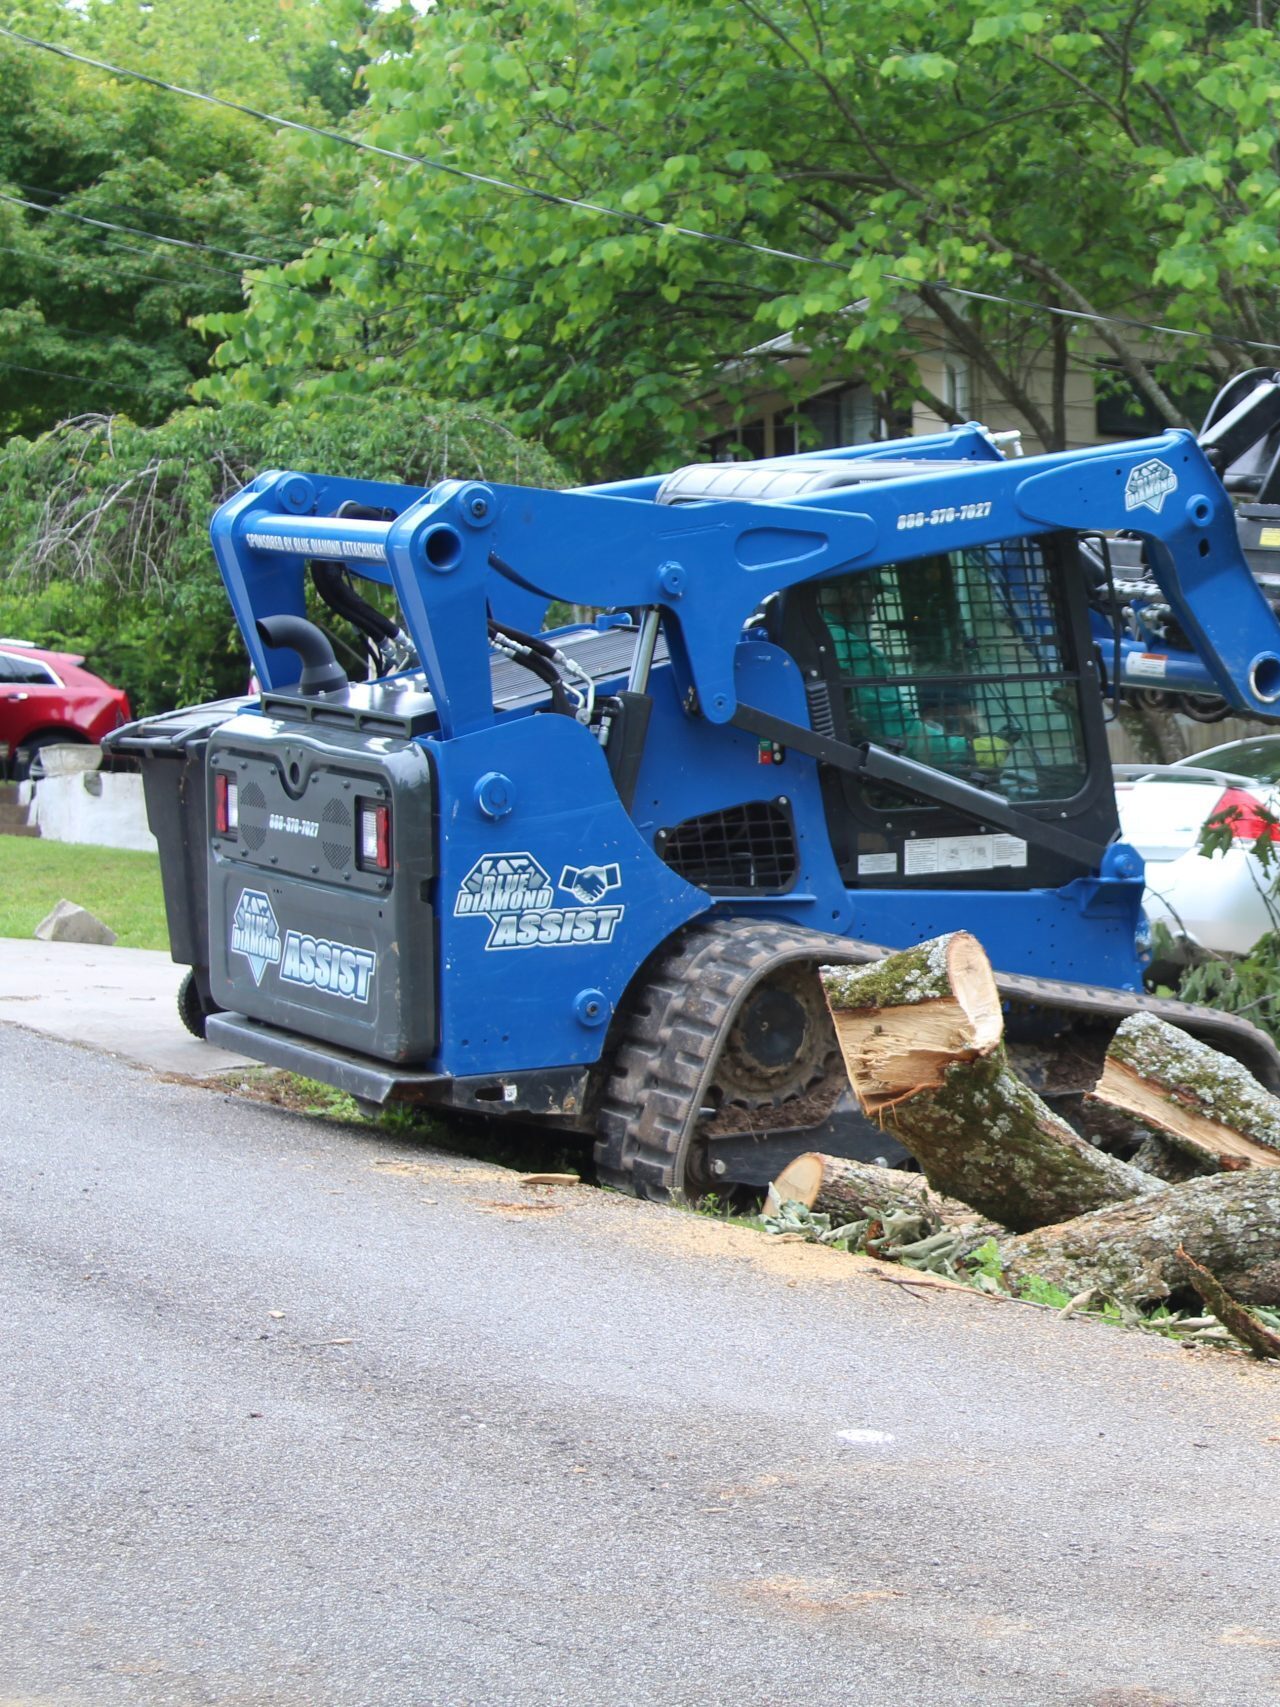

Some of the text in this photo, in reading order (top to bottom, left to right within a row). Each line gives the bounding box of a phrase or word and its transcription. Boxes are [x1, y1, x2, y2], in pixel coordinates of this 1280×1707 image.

[480, 873, 531, 893] BLUE
[457, 889, 552, 912] DIAMOND
[244, 912, 269, 937] BLUE
[491, 909, 620, 946] ASSIST
[233, 928, 281, 961] DIAMOND
[283, 936, 373, 997] ASSIST
